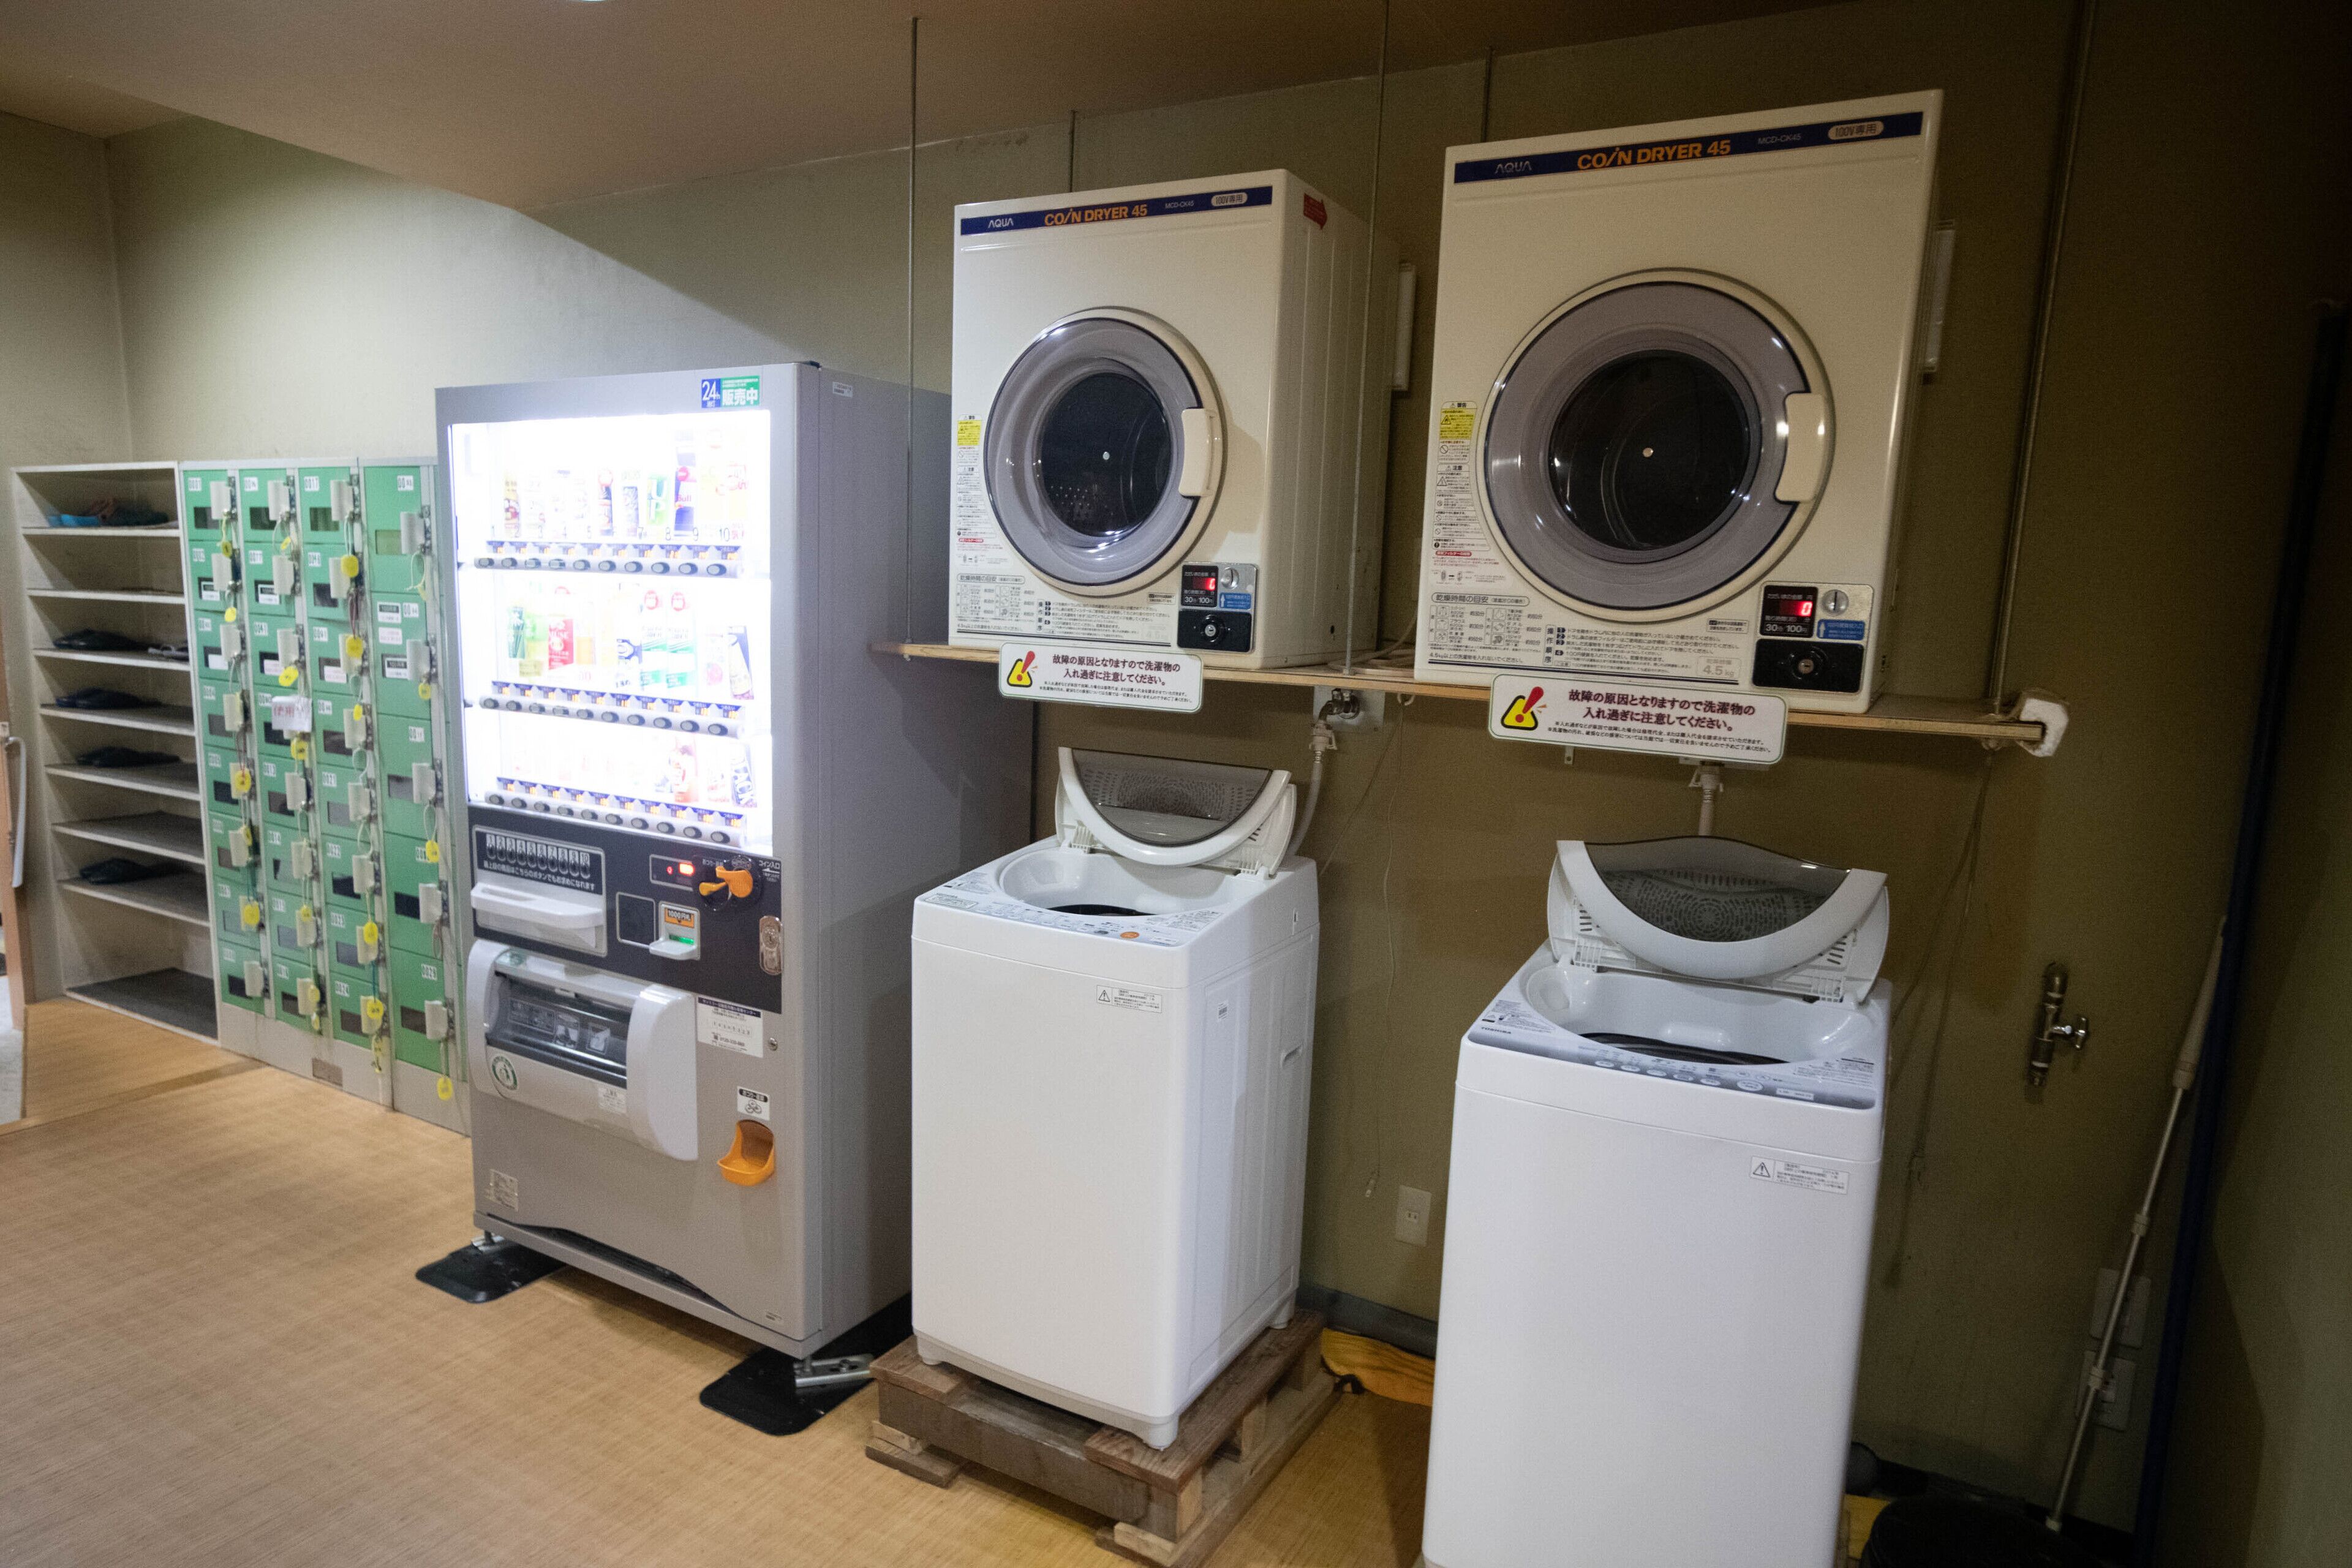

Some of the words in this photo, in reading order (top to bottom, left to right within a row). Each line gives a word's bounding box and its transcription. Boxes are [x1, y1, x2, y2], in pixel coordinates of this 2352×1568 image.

[1757, 134, 1801, 145] MCD-CK45
[1636, 142, 1702, 165] DRYER
[1707, 140, 1731, 156] 45
[1495, 160, 1532, 174] AQUA
[1085, 206, 1131, 223] DRYER
[1132, 204, 1147, 217] 45
[988, 218, 1014, 228] AQUA
[722, 387, 758, 405] 販売中
[665, 527, 671, 540] 8
[692, 527, 698, 541] 9
[720, 527, 730, 541] 10
[1436, 594, 1488, 603] 乾燥時間の目安
[1801, 601, 1813, 617] 0
[1052, 654, 1180, 672] 故障の原因となりますので洗濯物の
[1703, 665, 1723, 675] 4.5
[1063, 668, 1165, 685] 入れ過ぎに注意してください。
[1569, 689, 1755, 716] 故障の原因となりますので洗濯物の
[1583, 709, 1733, 732] 入れ過ぎに注意してください。
